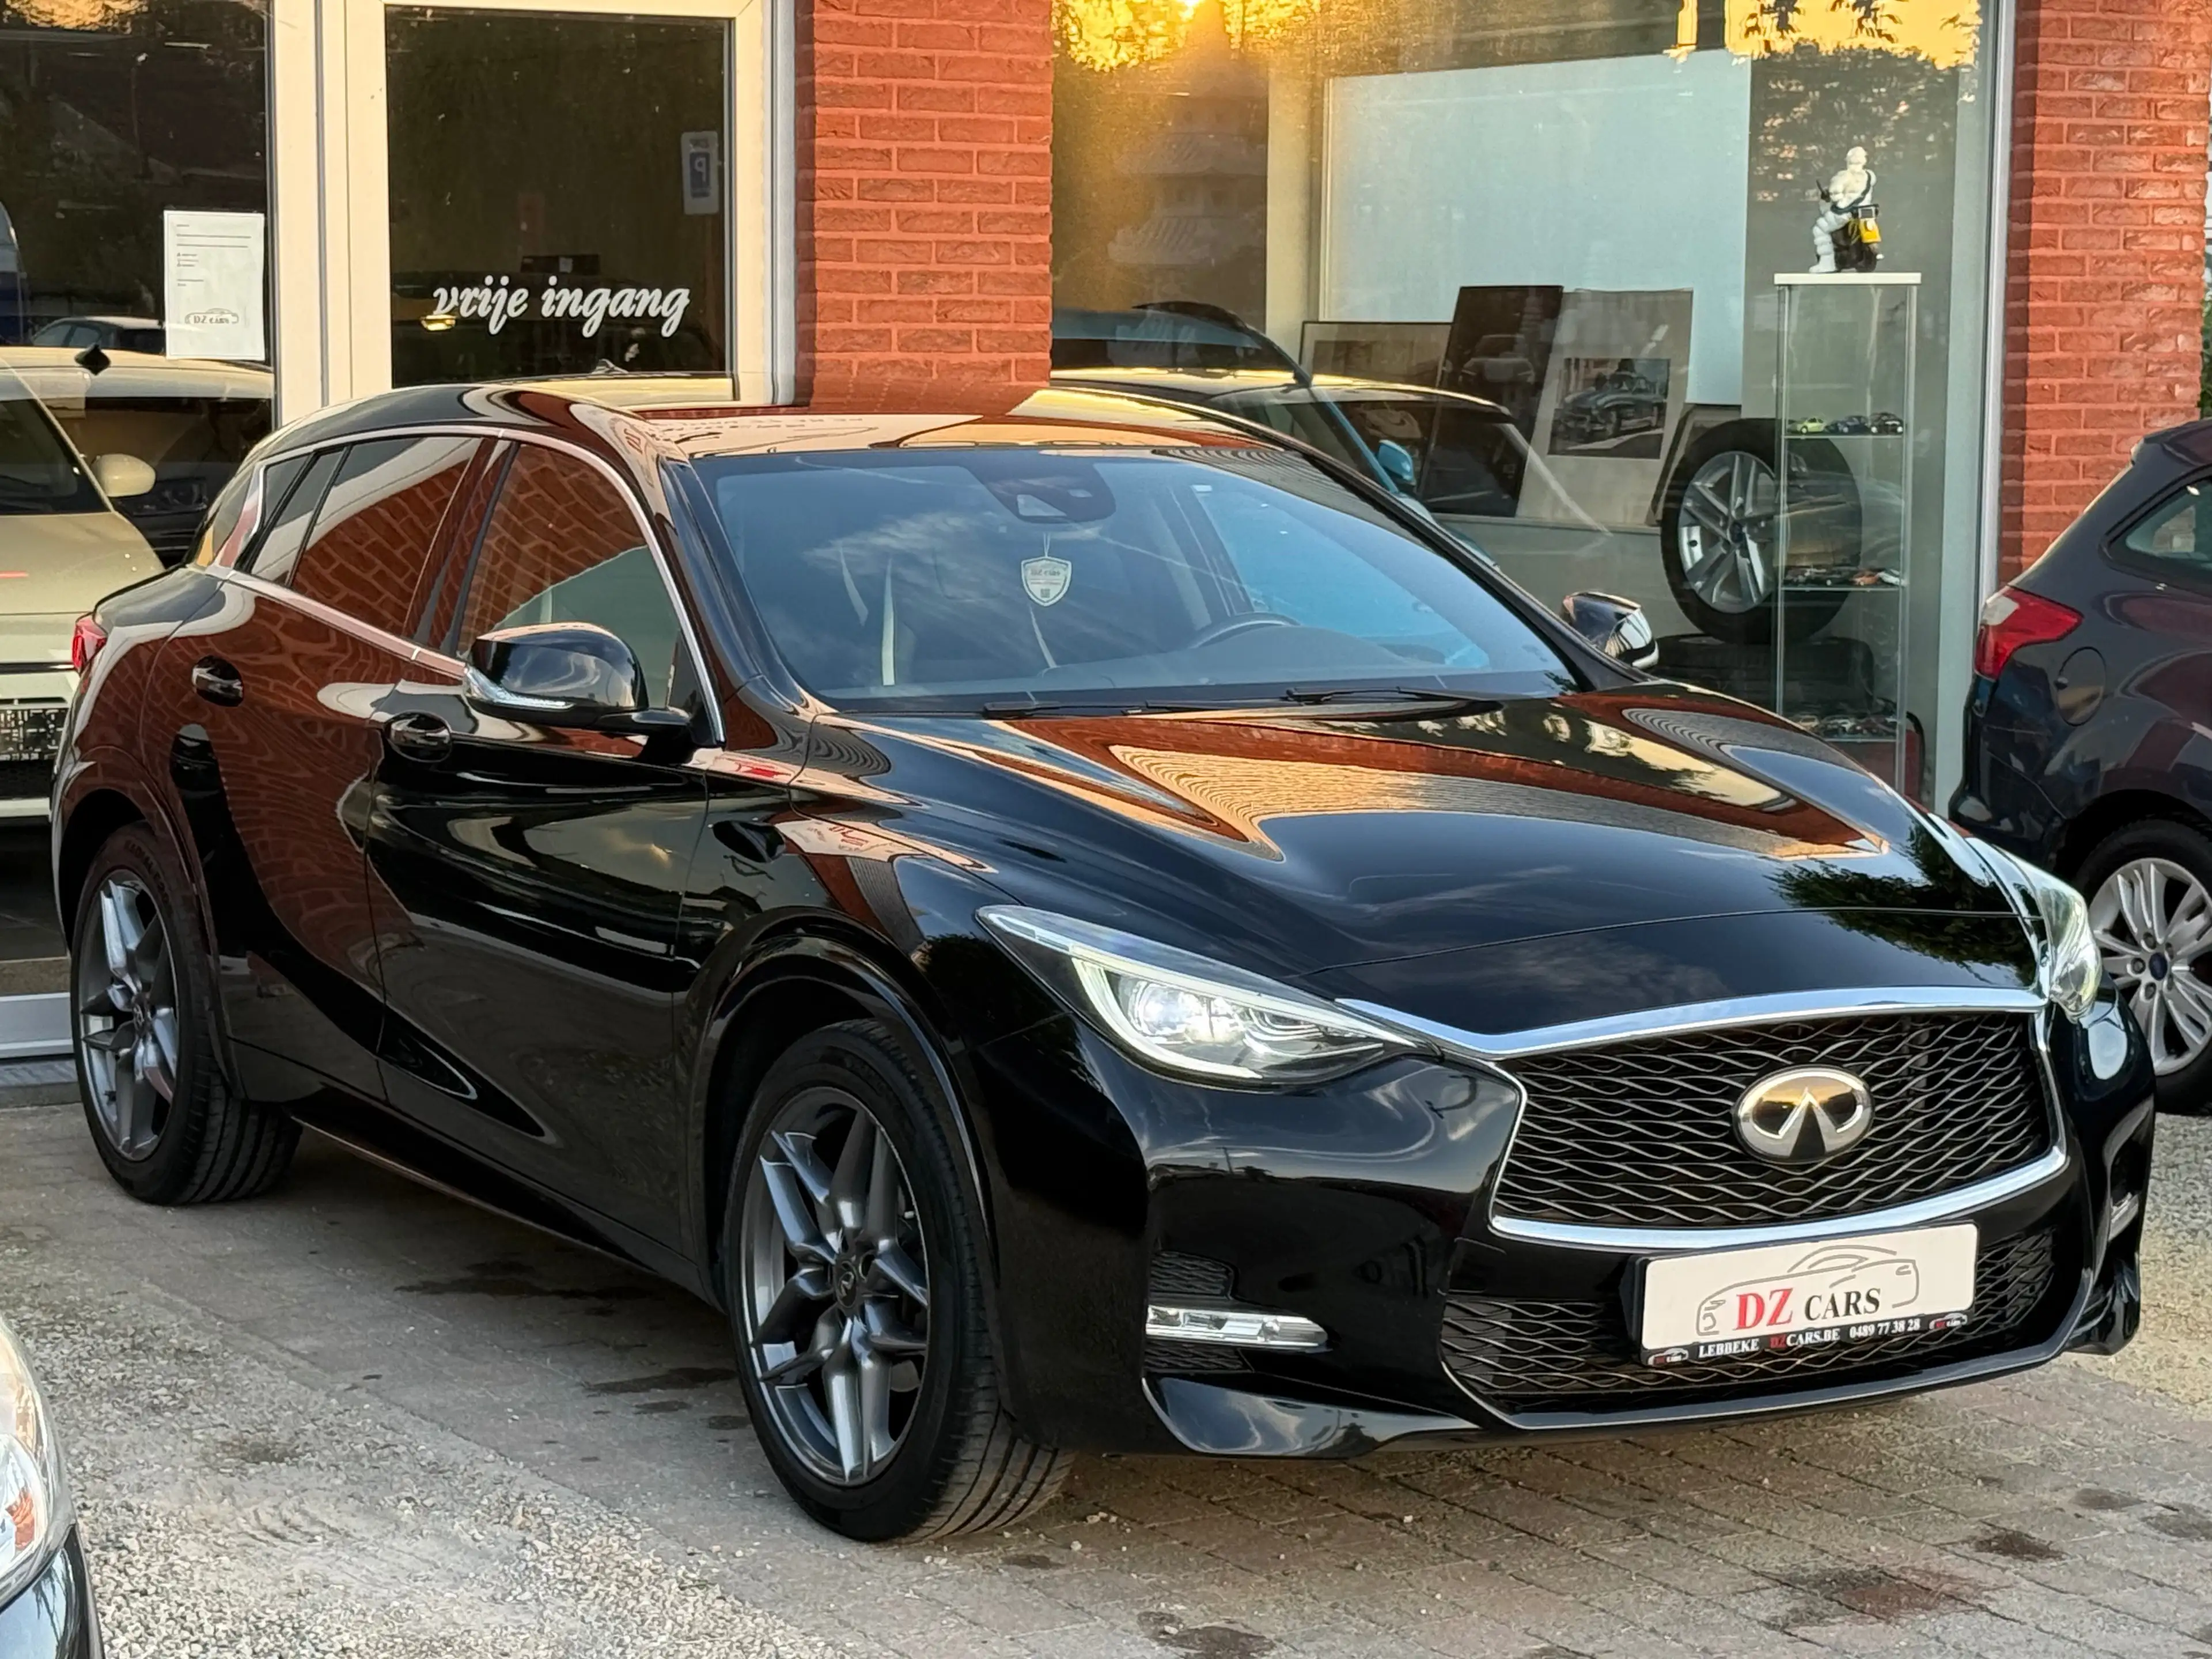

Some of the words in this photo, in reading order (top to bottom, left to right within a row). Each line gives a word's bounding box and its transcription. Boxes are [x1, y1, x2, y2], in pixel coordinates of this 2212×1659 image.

[433, 275, 529, 335] vrije
[541, 275, 690, 338] ingang
[1732, 1287, 1794, 1331] DZ
[1804, 1287, 1881, 1321] CARS
[1698, 1338, 1760, 1358] LEBBEKE
[1850, 1324, 1875, 1339] 0489
[1877, 1321, 1891, 1335] 77
[1891, 1320, 1906, 1334] 38
[1907, 1318, 1921, 1331] 28
